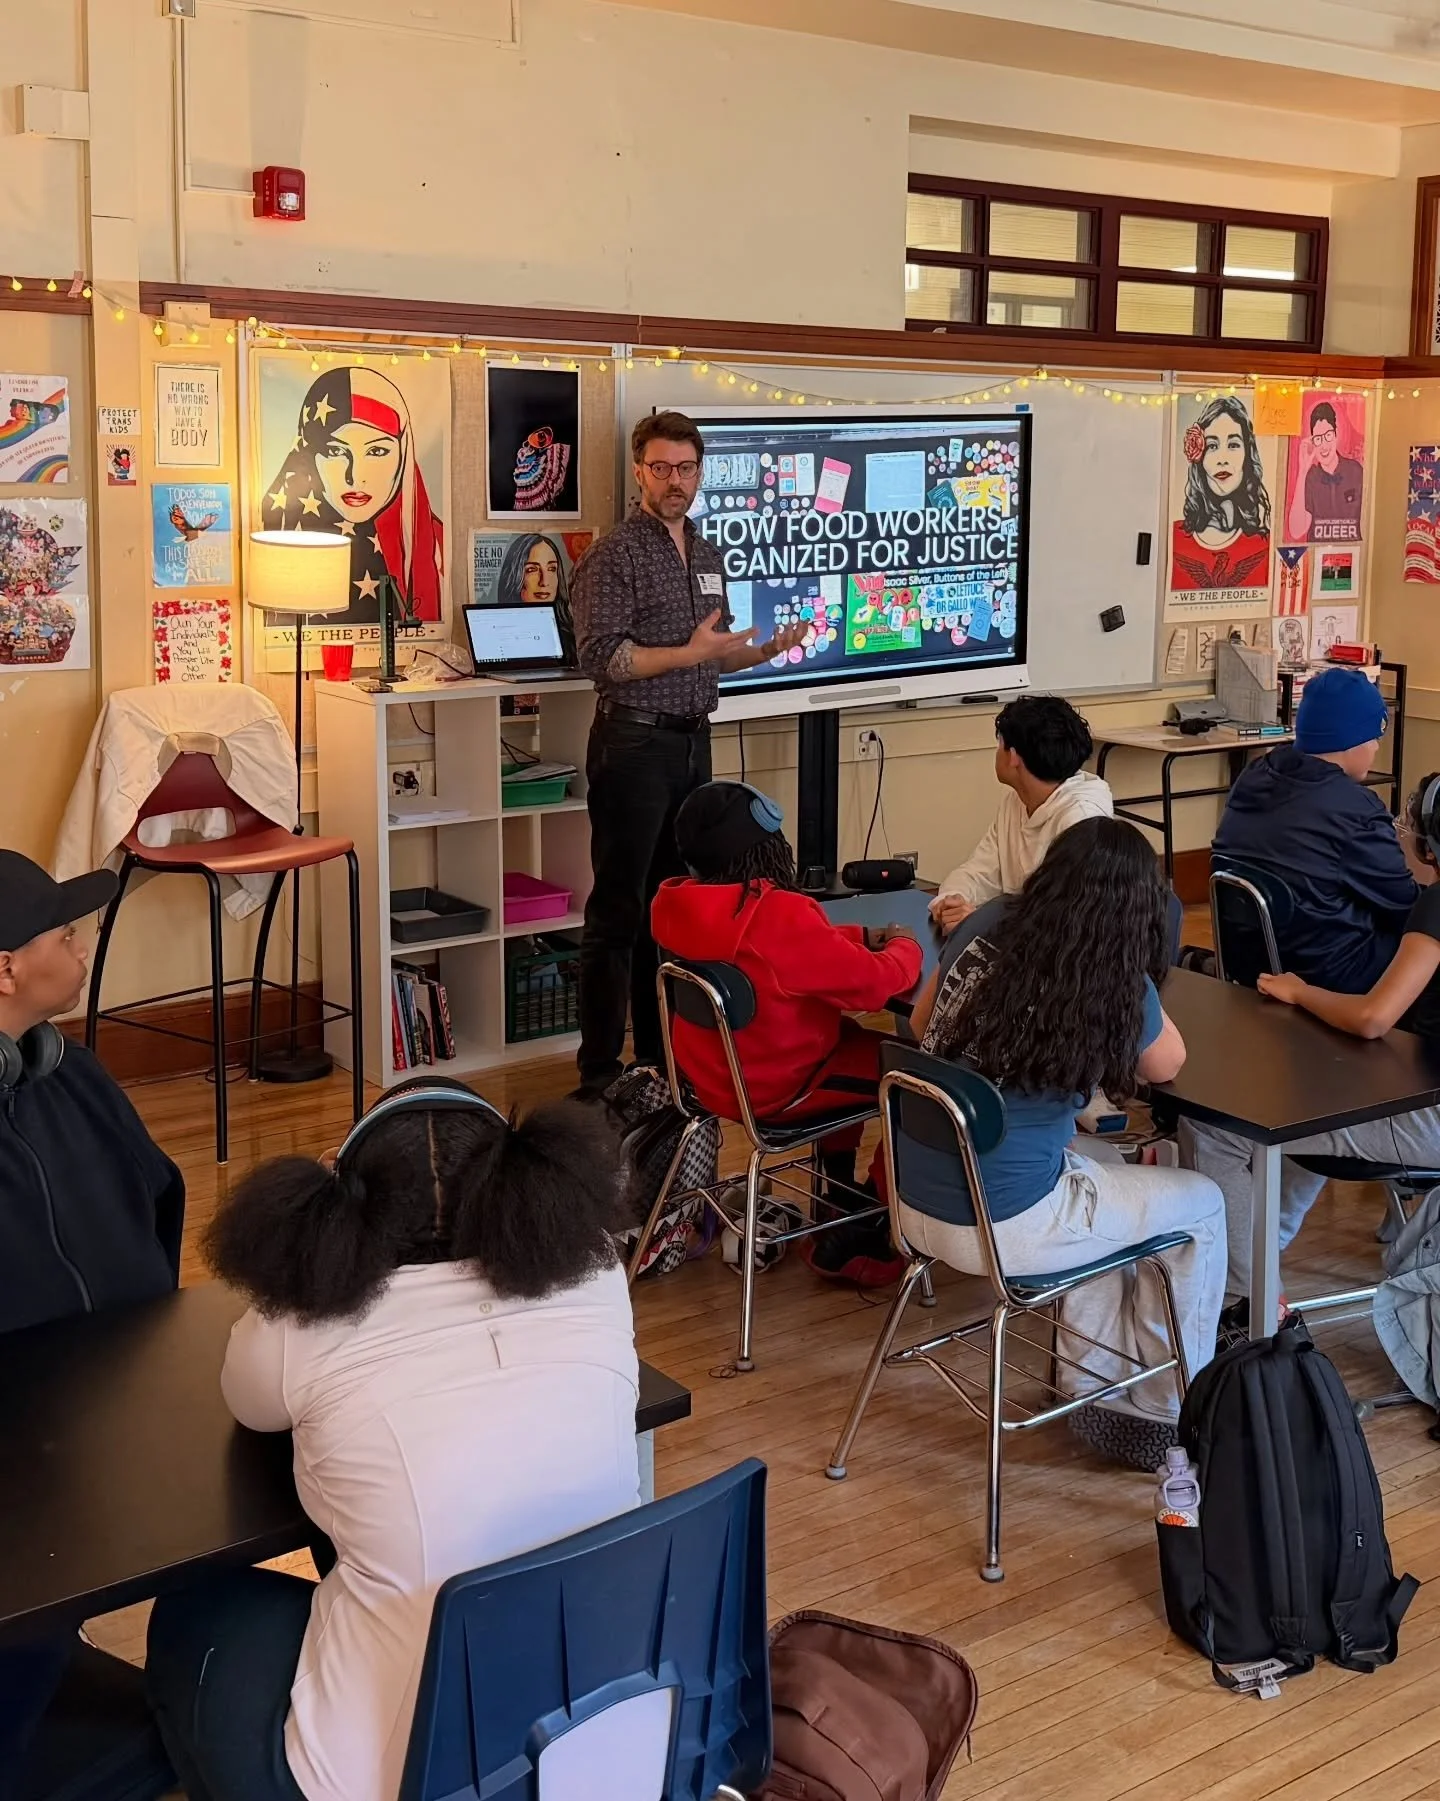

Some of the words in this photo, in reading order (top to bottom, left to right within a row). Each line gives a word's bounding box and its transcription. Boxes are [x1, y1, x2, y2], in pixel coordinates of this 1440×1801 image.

[171, 381, 195, 393] THERE
[197, 382, 205, 394] IS
[168, 393, 178, 404] NO
[180, 394, 209, 405] WRONG
[102, 408, 137, 418] PROTECT
[174, 406, 191, 416] WAY
[194, 406, 203, 417] TO
[106, 418, 132, 426] TRANS
[175, 418, 195, 428] HAVE
[196, 418, 202, 428] A
[109, 426, 129, 434] KIDS
[171, 429, 208, 447] BODY
[166, 487, 197, 502] TODOS
[702, 514, 778, 547] HOW
[786, 510, 868, 542] FOOD
[875, 505, 1002, 538] WORKERS
[1314, 526, 1358, 538] QUEER
[1407, 522, 1435, 539] LOCAL
[162, 545, 182, 562] THIS
[474, 548, 489, 559] SEE
[491, 547, 503, 558] NO
[723, 542, 849, 578] GANIZED
[857, 539, 910, 569] FOR
[916, 532, 1018, 565] JUSTICE
[474, 558, 502, 569] STRANGER
[884, 576, 908, 587] Isaac
[908, 574, 932, 586] Silver,
[935, 572, 966, 584] Buttons
[966, 570, 975, 581] of
[976, 569, 990, 580] the
[992, 568, 1007, 579] Left
[956, 582, 985, 598] LETTUCE
[1180, 592, 1196, 600] WE
[1199, 592, 1218, 600] THE
[1220, 590, 1258, 600] PEOPLE
[936, 600, 946, 614] OR
[948, 598, 968, 612] GALLO
[170, 616, 192, 630] Own
[194, 616, 216, 629] Your
[282, 631, 313, 643] WE
[318, 629, 354, 641] THE
[359, 627, 426, 640] PEPLE
[184, 639, 198, 648] And
[176, 646, 192, 656] You
[181, 672, 208, 682] Other
